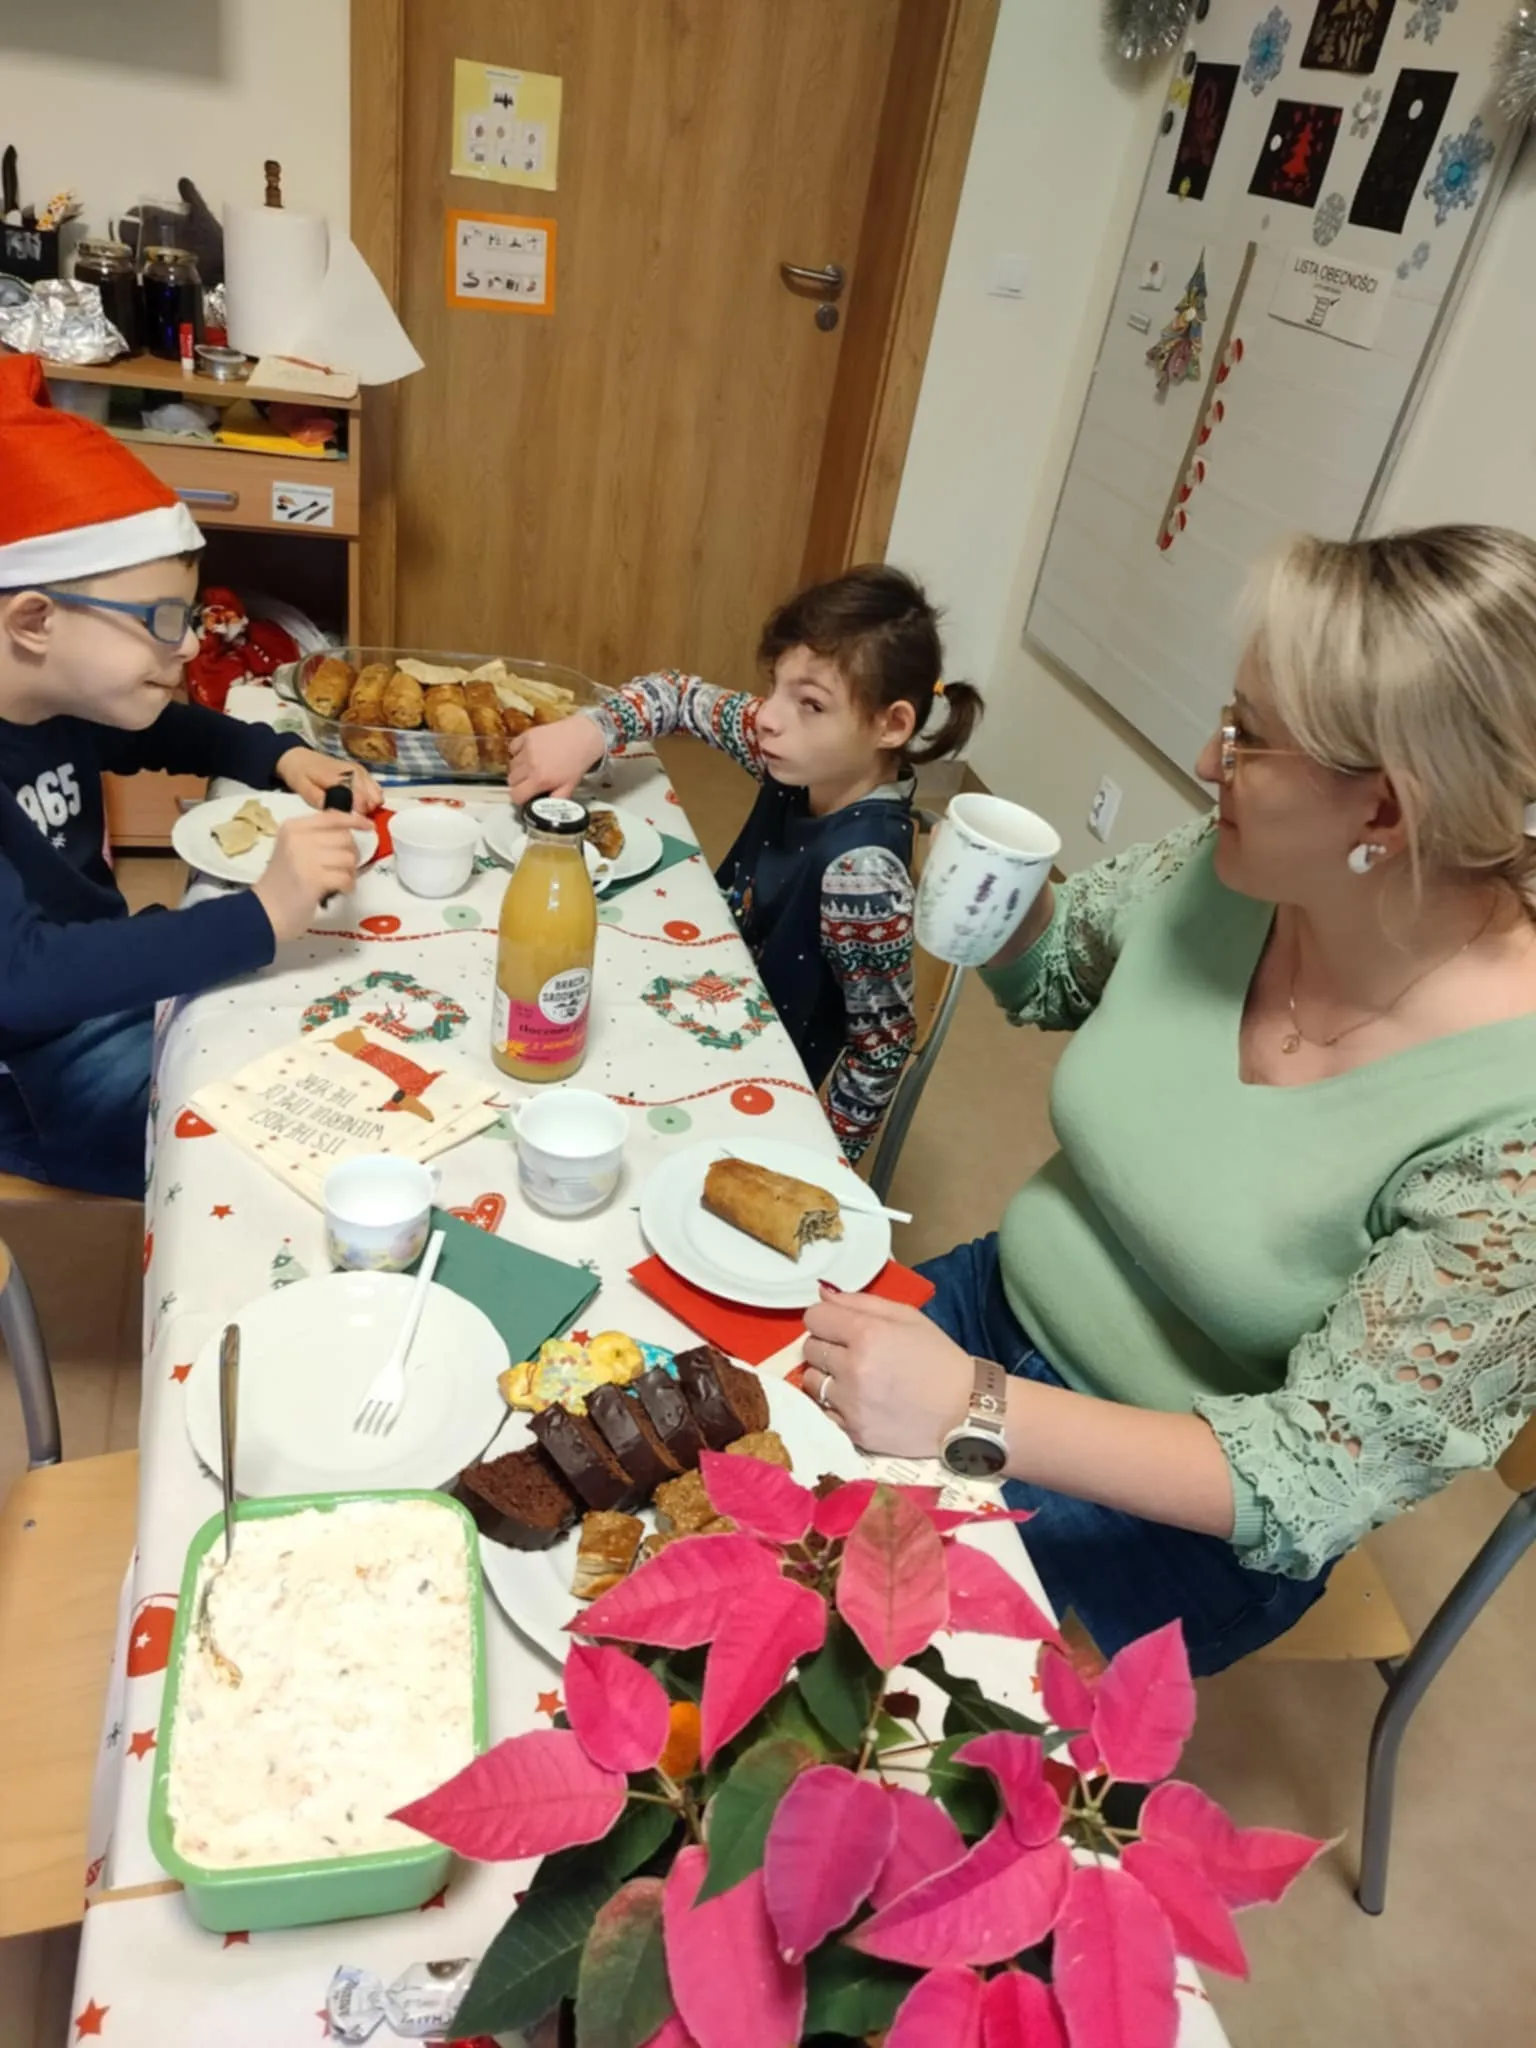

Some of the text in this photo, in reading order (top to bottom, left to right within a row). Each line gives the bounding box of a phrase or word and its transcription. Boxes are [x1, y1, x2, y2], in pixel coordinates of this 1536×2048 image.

[1294, 256, 1319, 275] LISTA
[1319, 264, 1379, 293] OBECNOŚCI
[257, 1083, 288, 1101] OF
[295, 1072, 358, 1109] THE YEAR
[274, 1092, 315, 1116] TIME
[247, 1108, 297, 1134] MOST
[283, 1122, 318, 1145] THE
